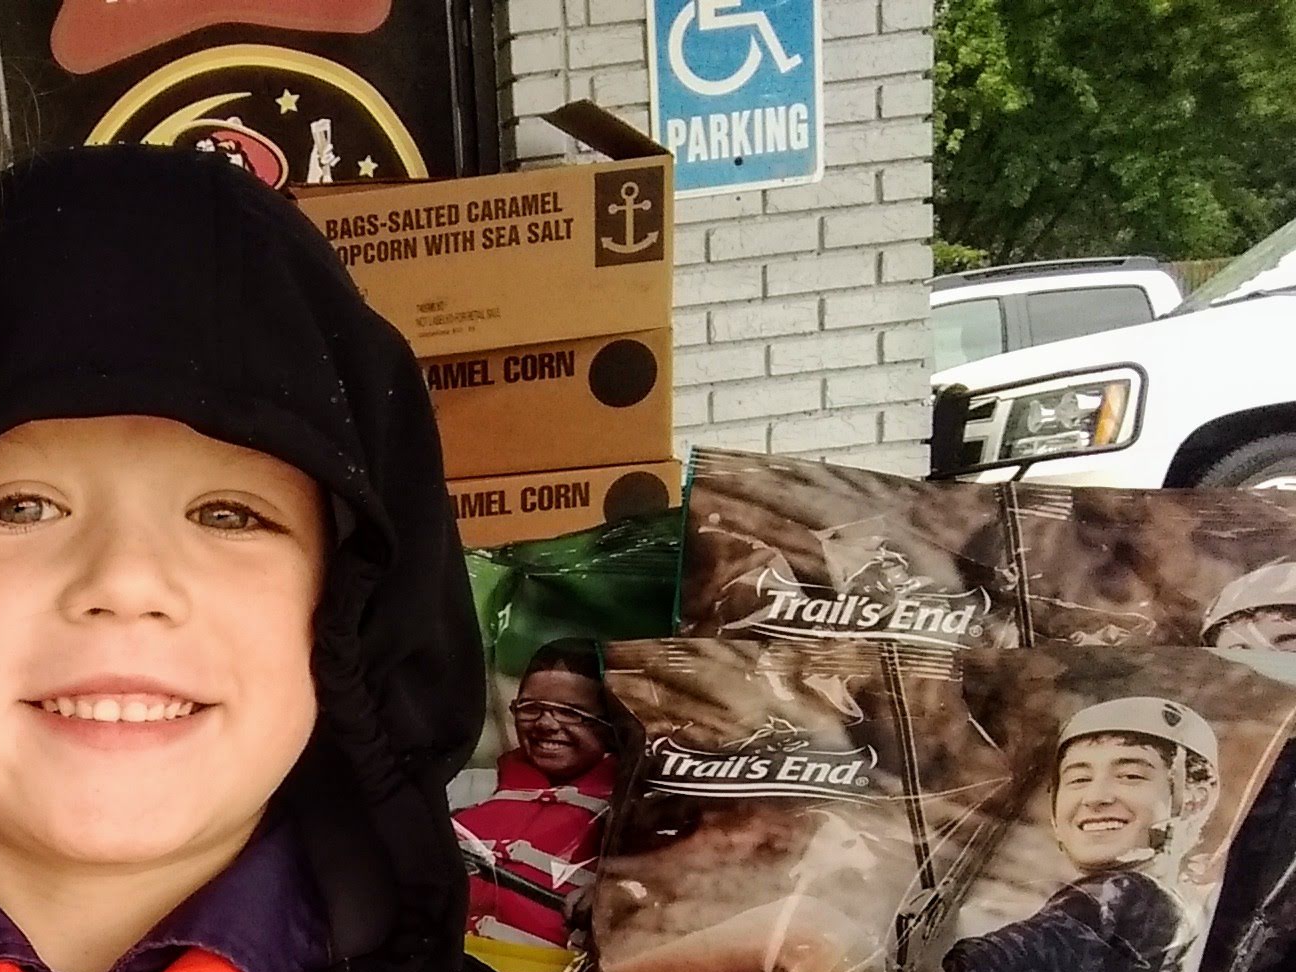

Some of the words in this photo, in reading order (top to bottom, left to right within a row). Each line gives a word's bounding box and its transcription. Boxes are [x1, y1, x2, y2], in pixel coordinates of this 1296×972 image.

[667, 103, 809, 164] PARKING
[325, 203, 460, 241] BAGS-SALTED
[466, 191, 563, 224] CARAMEL
[423, 230, 475, 257] WITH
[481, 224, 521, 250] SEA
[527, 218, 574, 244] SALT
[504, 350, 575, 384] CORN
[520, 481, 590, 513] CORN
[766, 589, 883, 627] Trail's
[888, 599, 978, 635] End
[661, 750, 771, 780] Trail's
[775, 756, 865, 786] End
